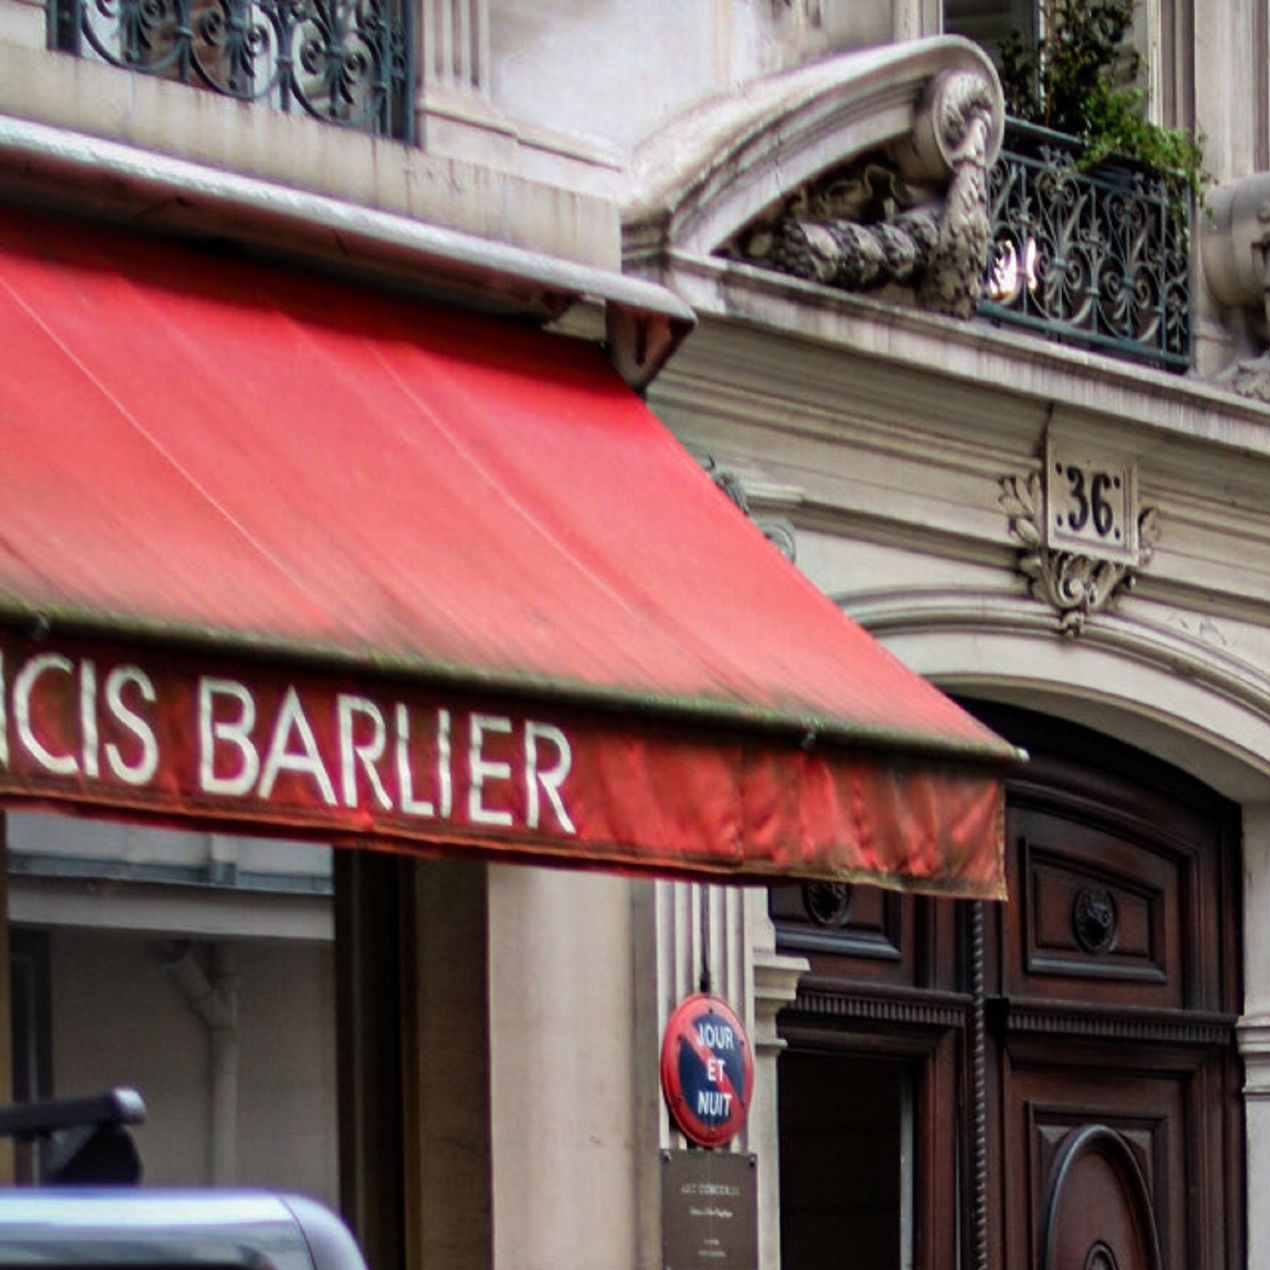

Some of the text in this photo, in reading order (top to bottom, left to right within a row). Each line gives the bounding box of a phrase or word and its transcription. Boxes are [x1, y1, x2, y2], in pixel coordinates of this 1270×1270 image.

[0, 650, 578, 834] CIS BARLIER
[696, 1022, 735, 1051] JOUR
[707, 1057, 725, 1082] ET
[697, 1090, 733, 1117] NUIT
